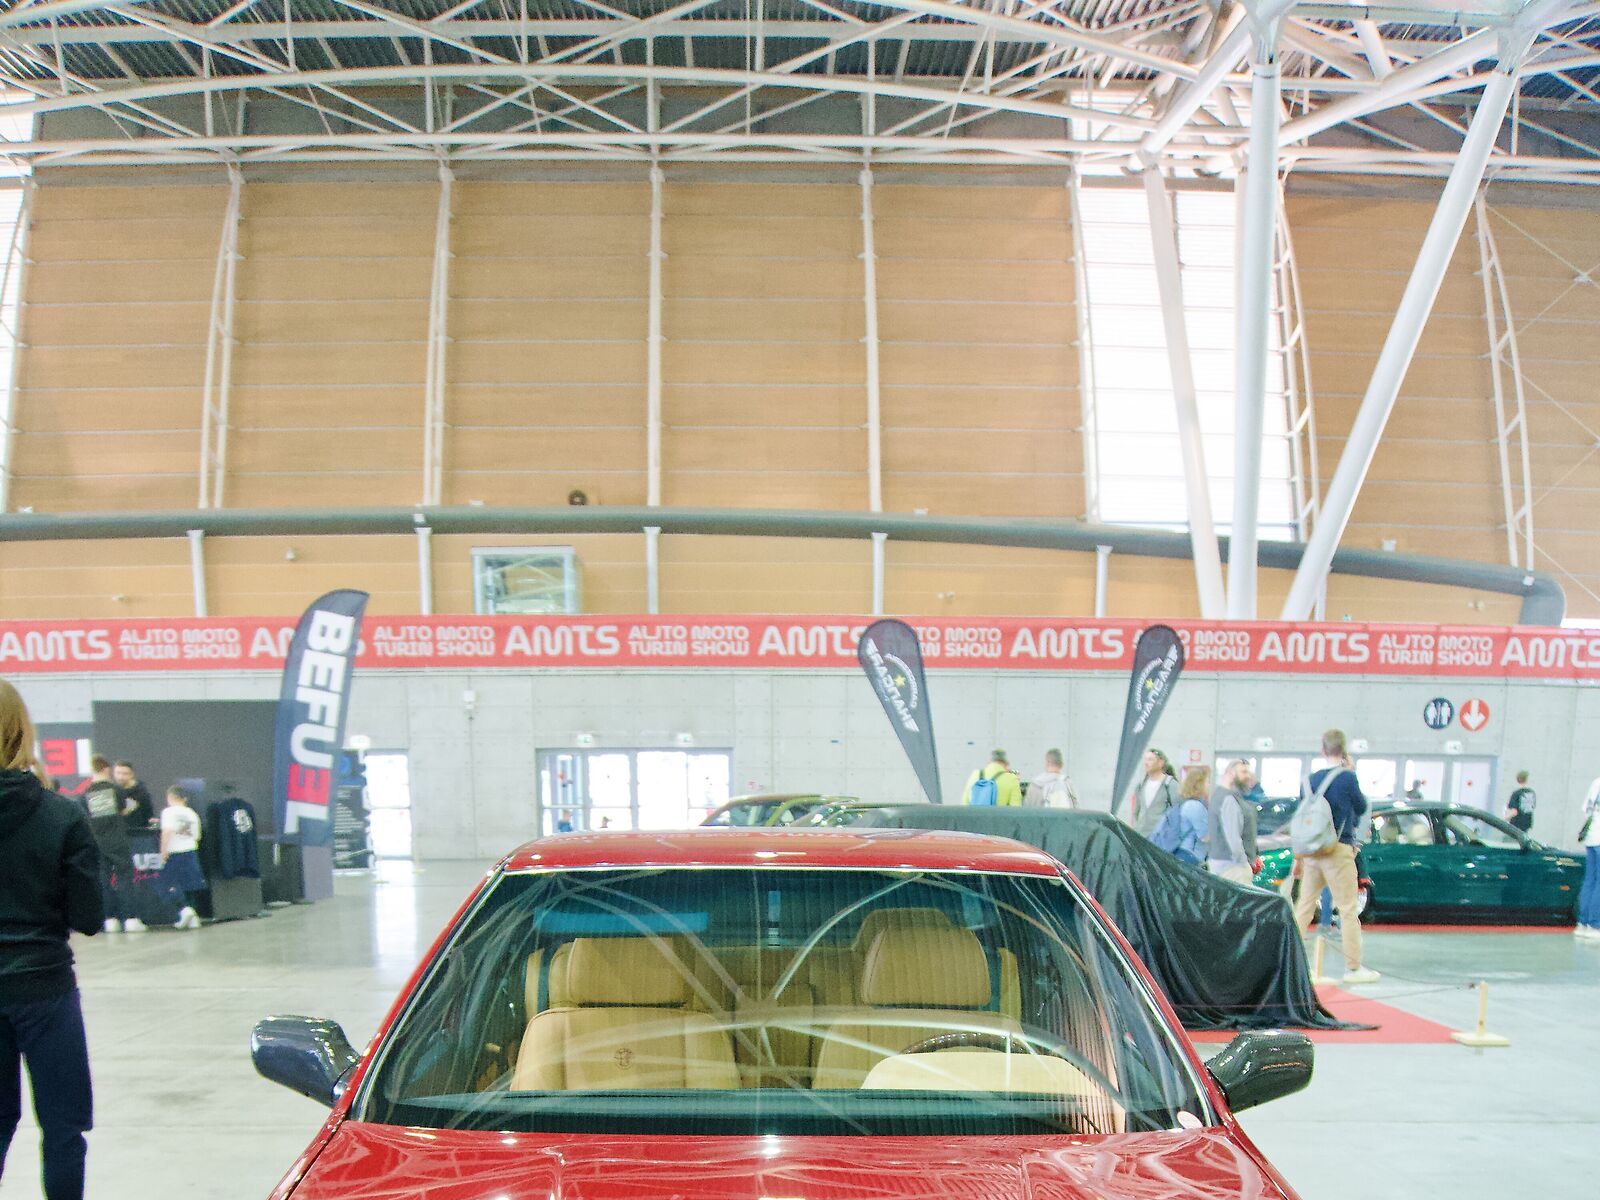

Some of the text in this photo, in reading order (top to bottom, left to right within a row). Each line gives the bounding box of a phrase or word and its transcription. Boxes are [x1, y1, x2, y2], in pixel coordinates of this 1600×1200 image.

[119, 629, 178, 644] AUTO
[182, 627, 239, 643] MOTO
[373, 625, 494, 641] AUTO MOTO
[503, 625, 620, 656] AMTS
[628, 625, 749, 641] AUTO MOTO
[944, 626, 1002, 642] MOTO
[1194, 630, 1250, 646] MOTO
[0, 630, 112, 662] AMTS
[373, 641, 434, 657] TURIN
[436, 641, 496, 657] SHOW
[628, 640, 750, 656] TURIN SHOW
[944, 642, 1002, 658] SHOW
[1010, 628, 1125, 659] AMTS
[1258, 632, 1370, 663] AMTS
[1378, 633, 1493, 651] AUTO MOTO
[119, 643, 242, 660] TURIN SHOW
[1194, 646, 1251, 662] SHOW
[1378, 649, 1493, 667] TURIN SHOW
